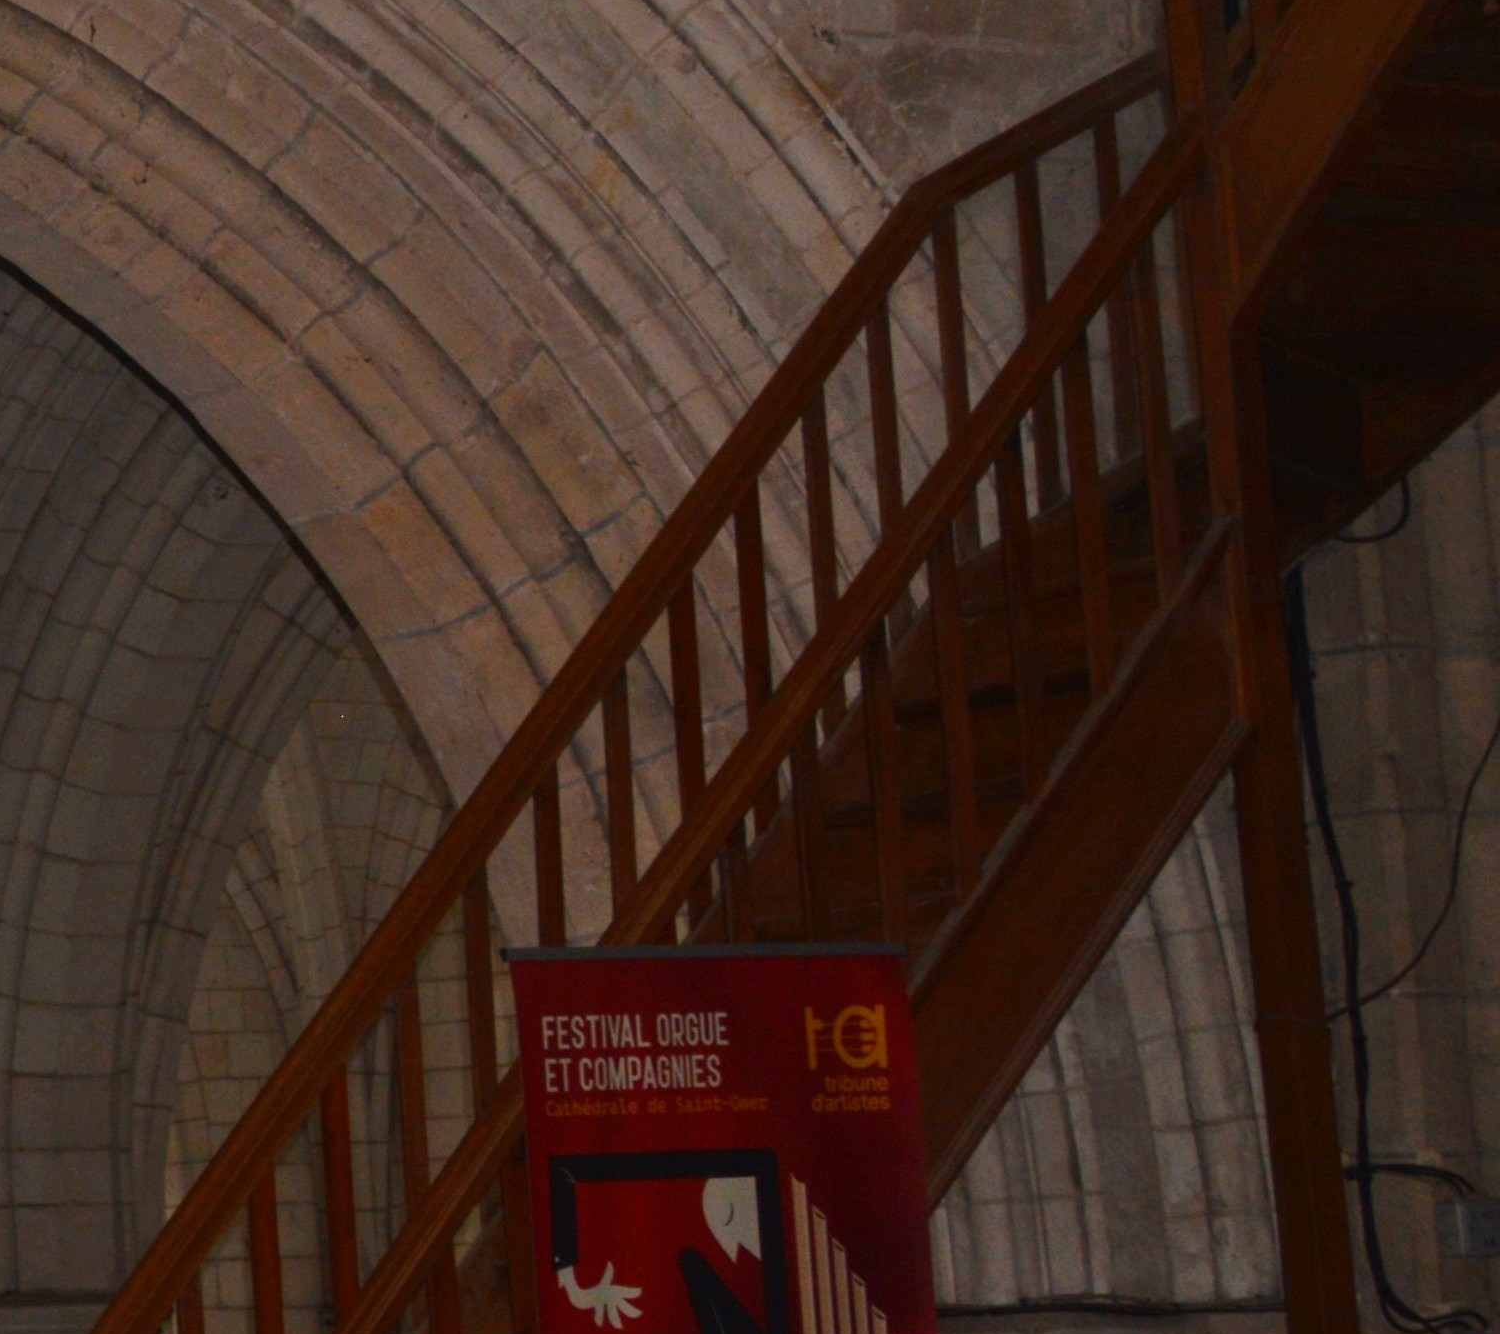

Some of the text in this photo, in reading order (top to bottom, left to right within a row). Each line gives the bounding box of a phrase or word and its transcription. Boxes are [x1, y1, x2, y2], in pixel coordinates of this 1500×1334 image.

[542, 1012, 729, 1050] FESTIVAL ORGUE
[544, 1054, 722, 1093] ET COMPAGNIES
[825, 1075, 889, 1094] tribune
[545, 1094, 768, 1117] Cathédrale de Saint-Omer
[811, 1094, 891, 1114] d'artistes
